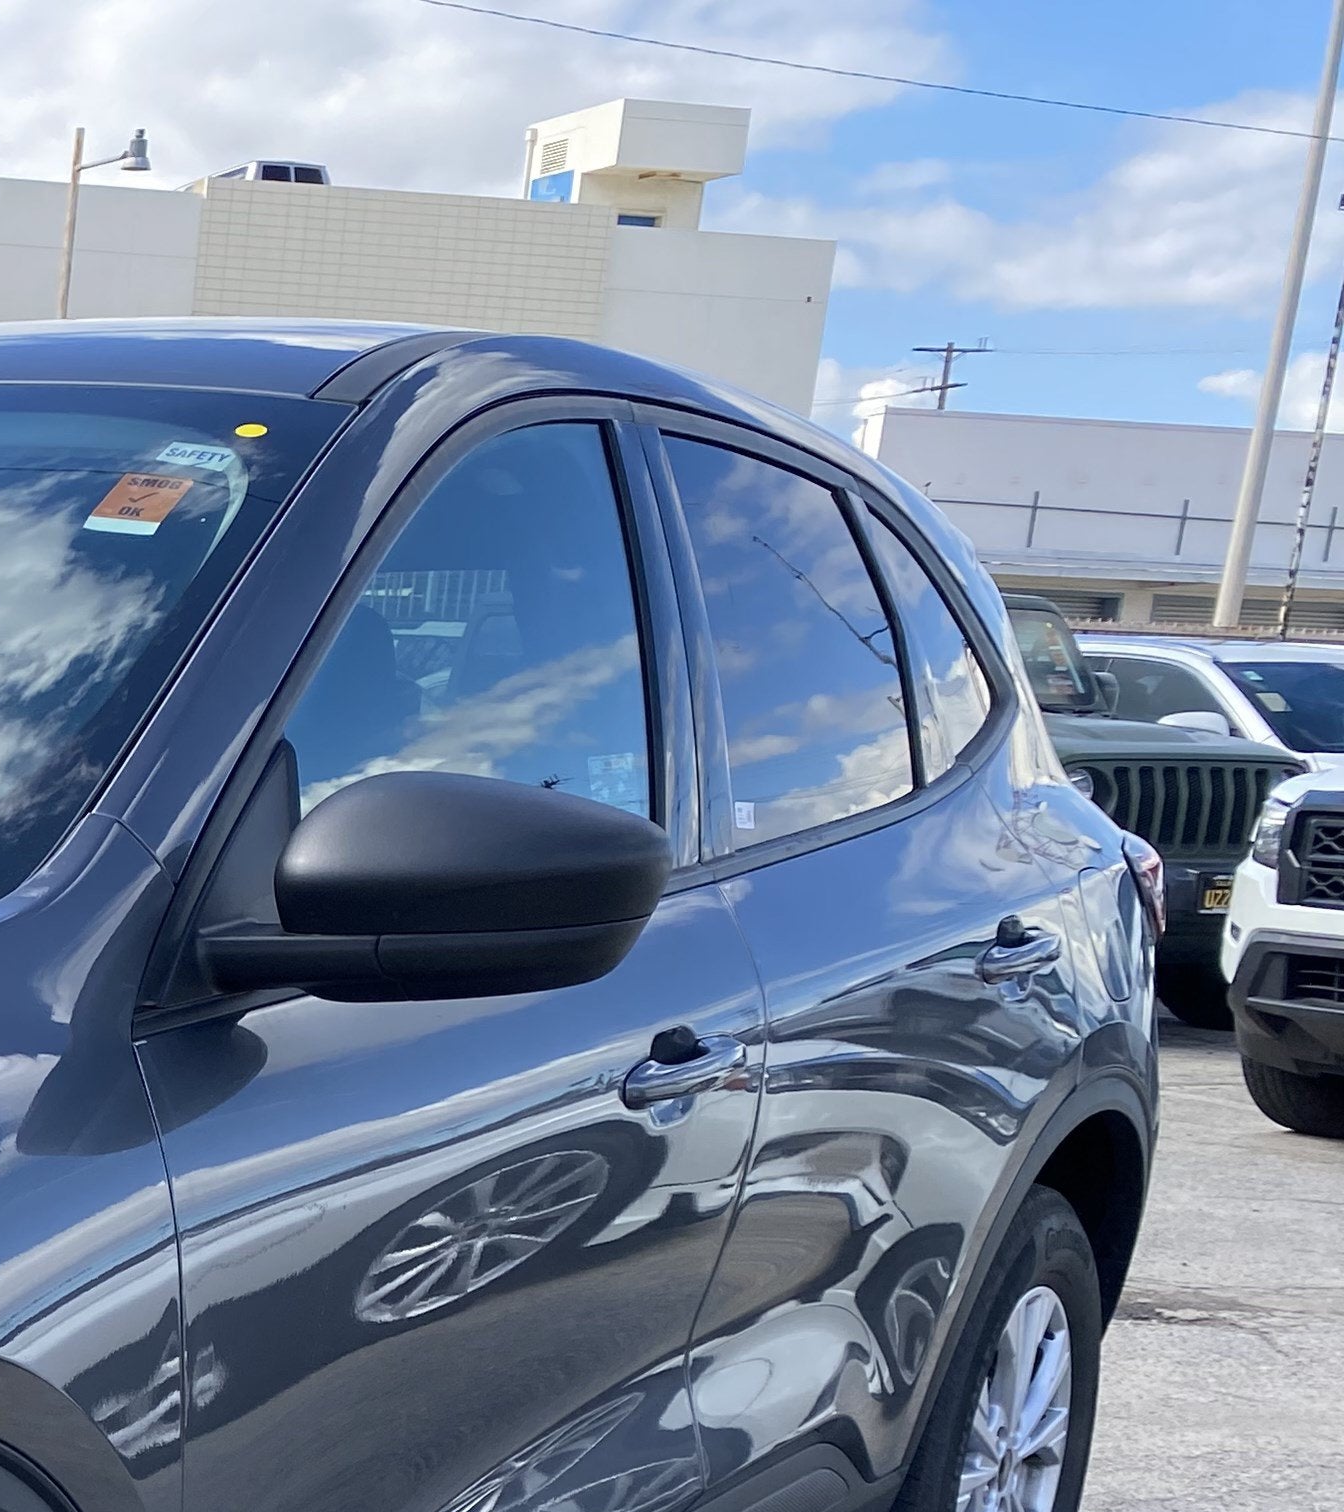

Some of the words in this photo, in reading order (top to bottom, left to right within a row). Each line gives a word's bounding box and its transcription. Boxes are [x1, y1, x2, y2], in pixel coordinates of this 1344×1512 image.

[166, 447, 232, 463] SAFETY
[127, 477, 184, 490] SMOG
[118, 506, 146, 517] OK
